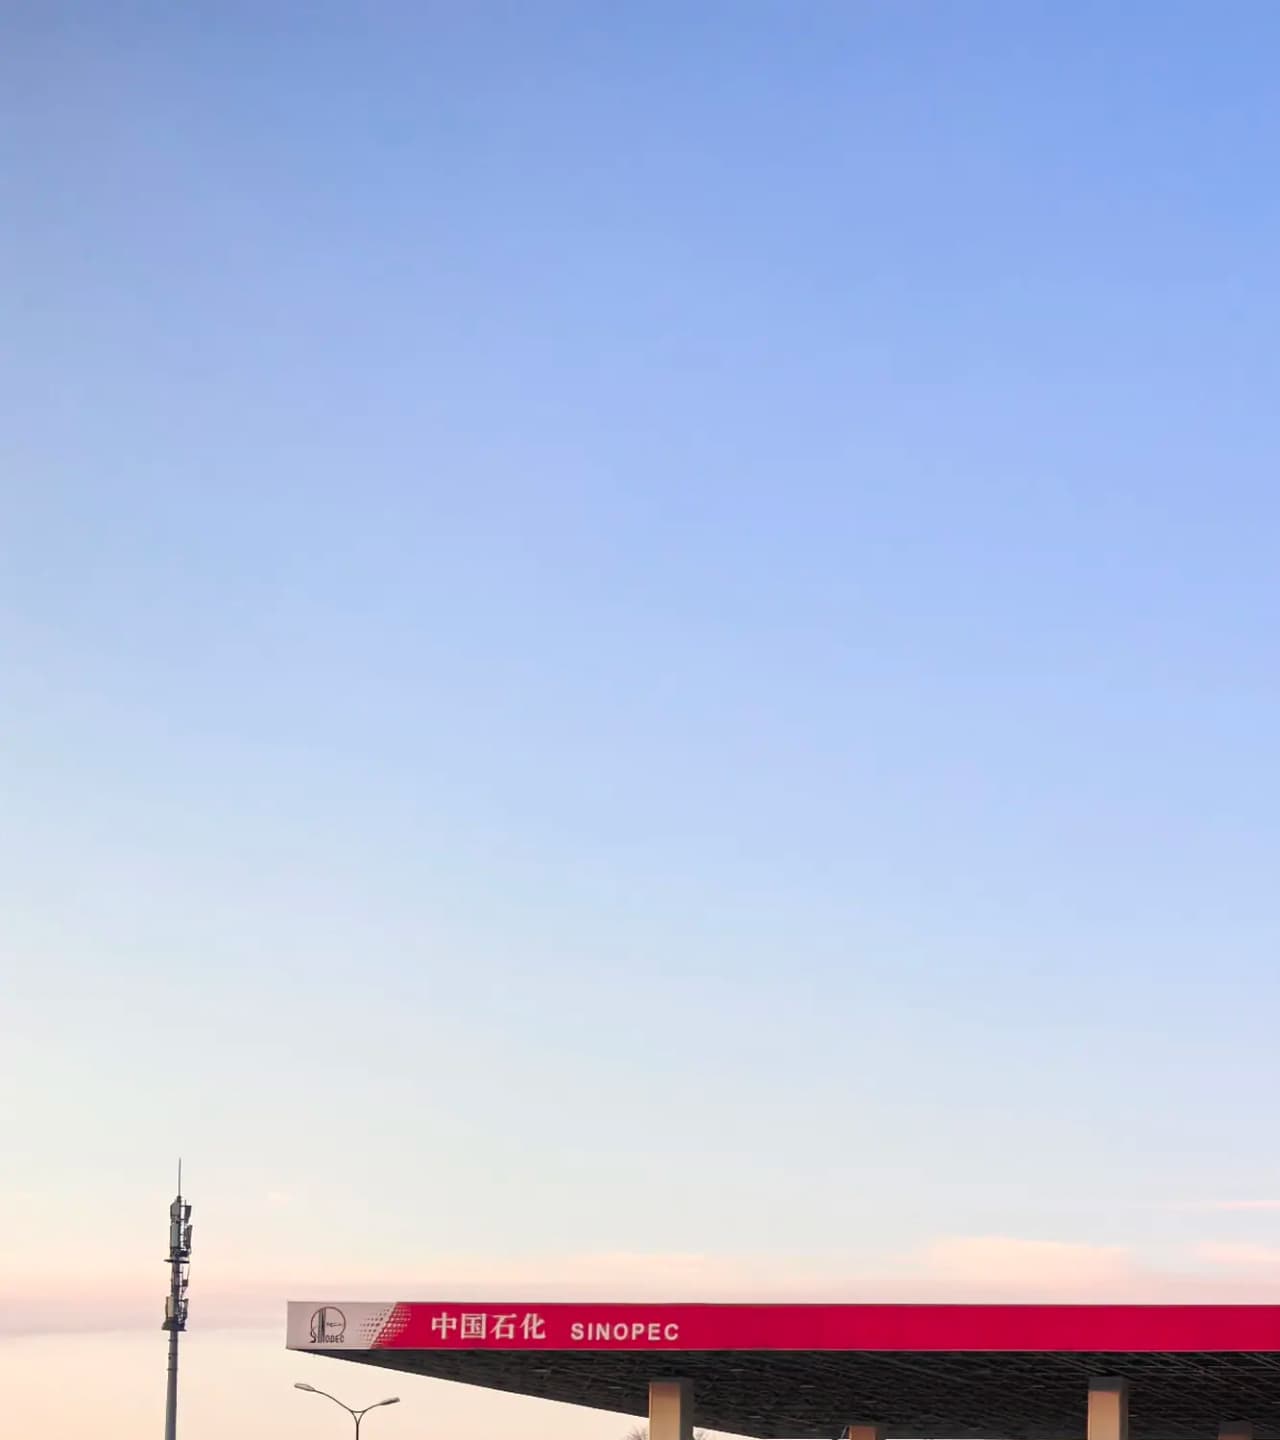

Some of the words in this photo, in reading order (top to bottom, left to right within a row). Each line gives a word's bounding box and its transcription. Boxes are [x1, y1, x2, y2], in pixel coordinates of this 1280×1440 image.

[431, 1312, 546, 1340] 中国石化
[570, 1322, 680, 1341] SINOPEC
